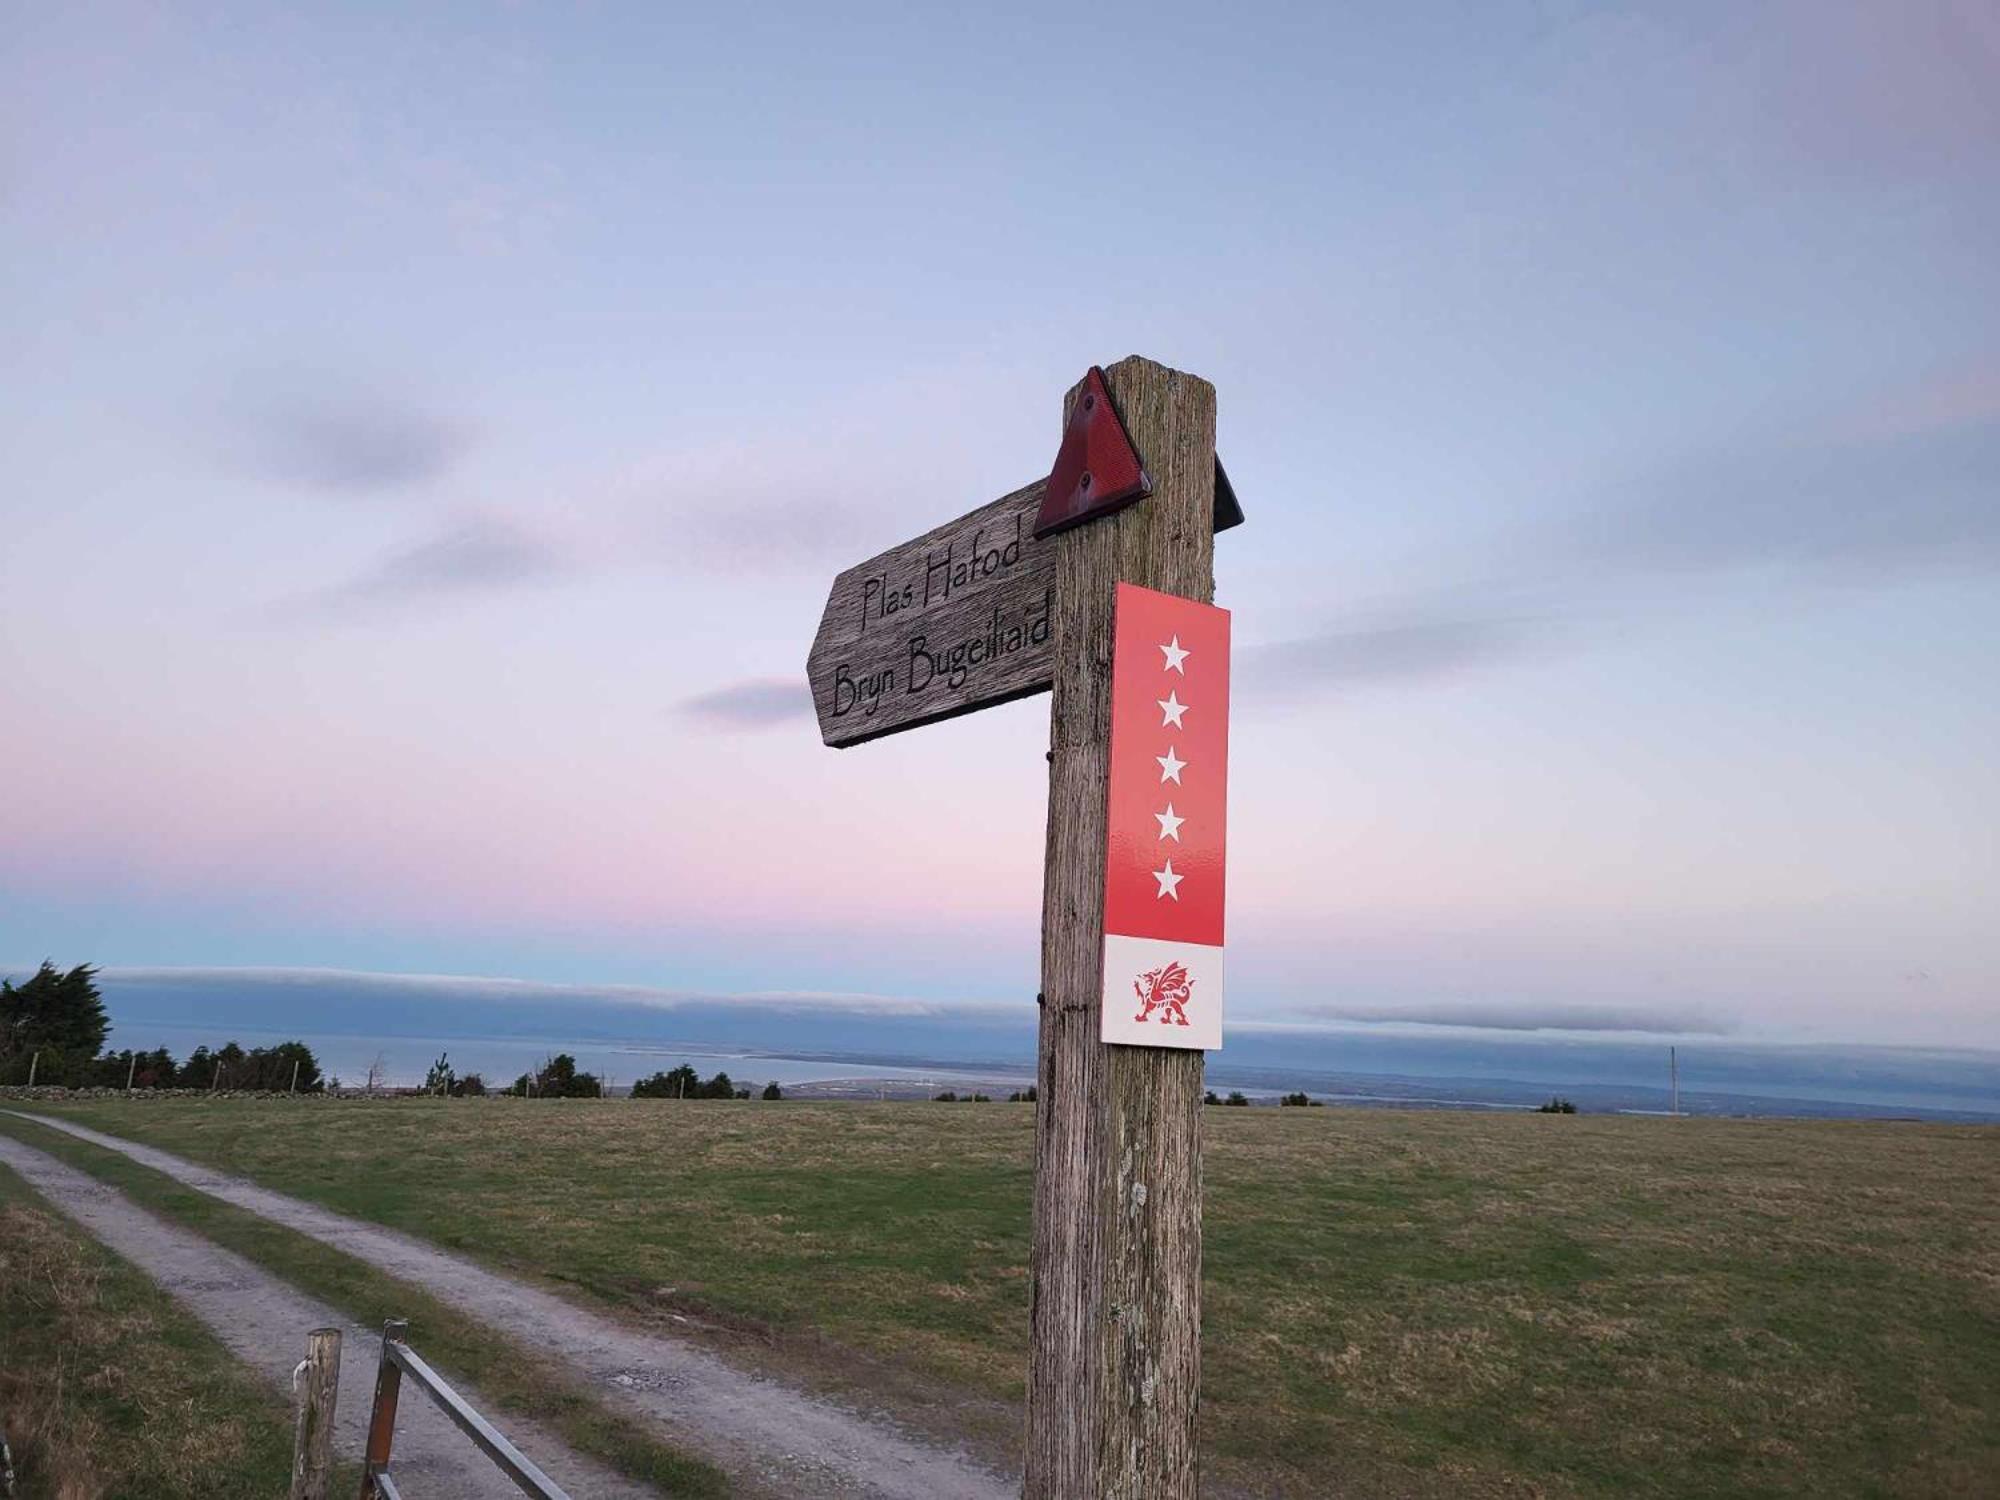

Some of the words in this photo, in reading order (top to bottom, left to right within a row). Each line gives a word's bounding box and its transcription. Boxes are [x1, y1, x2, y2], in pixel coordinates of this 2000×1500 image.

[862, 572, 913, 631] Plas
[923, 513, 1022, 608] Hafod
[831, 663, 894, 716] Bryn
[906, 589, 1050, 695] Bugeiliaid
